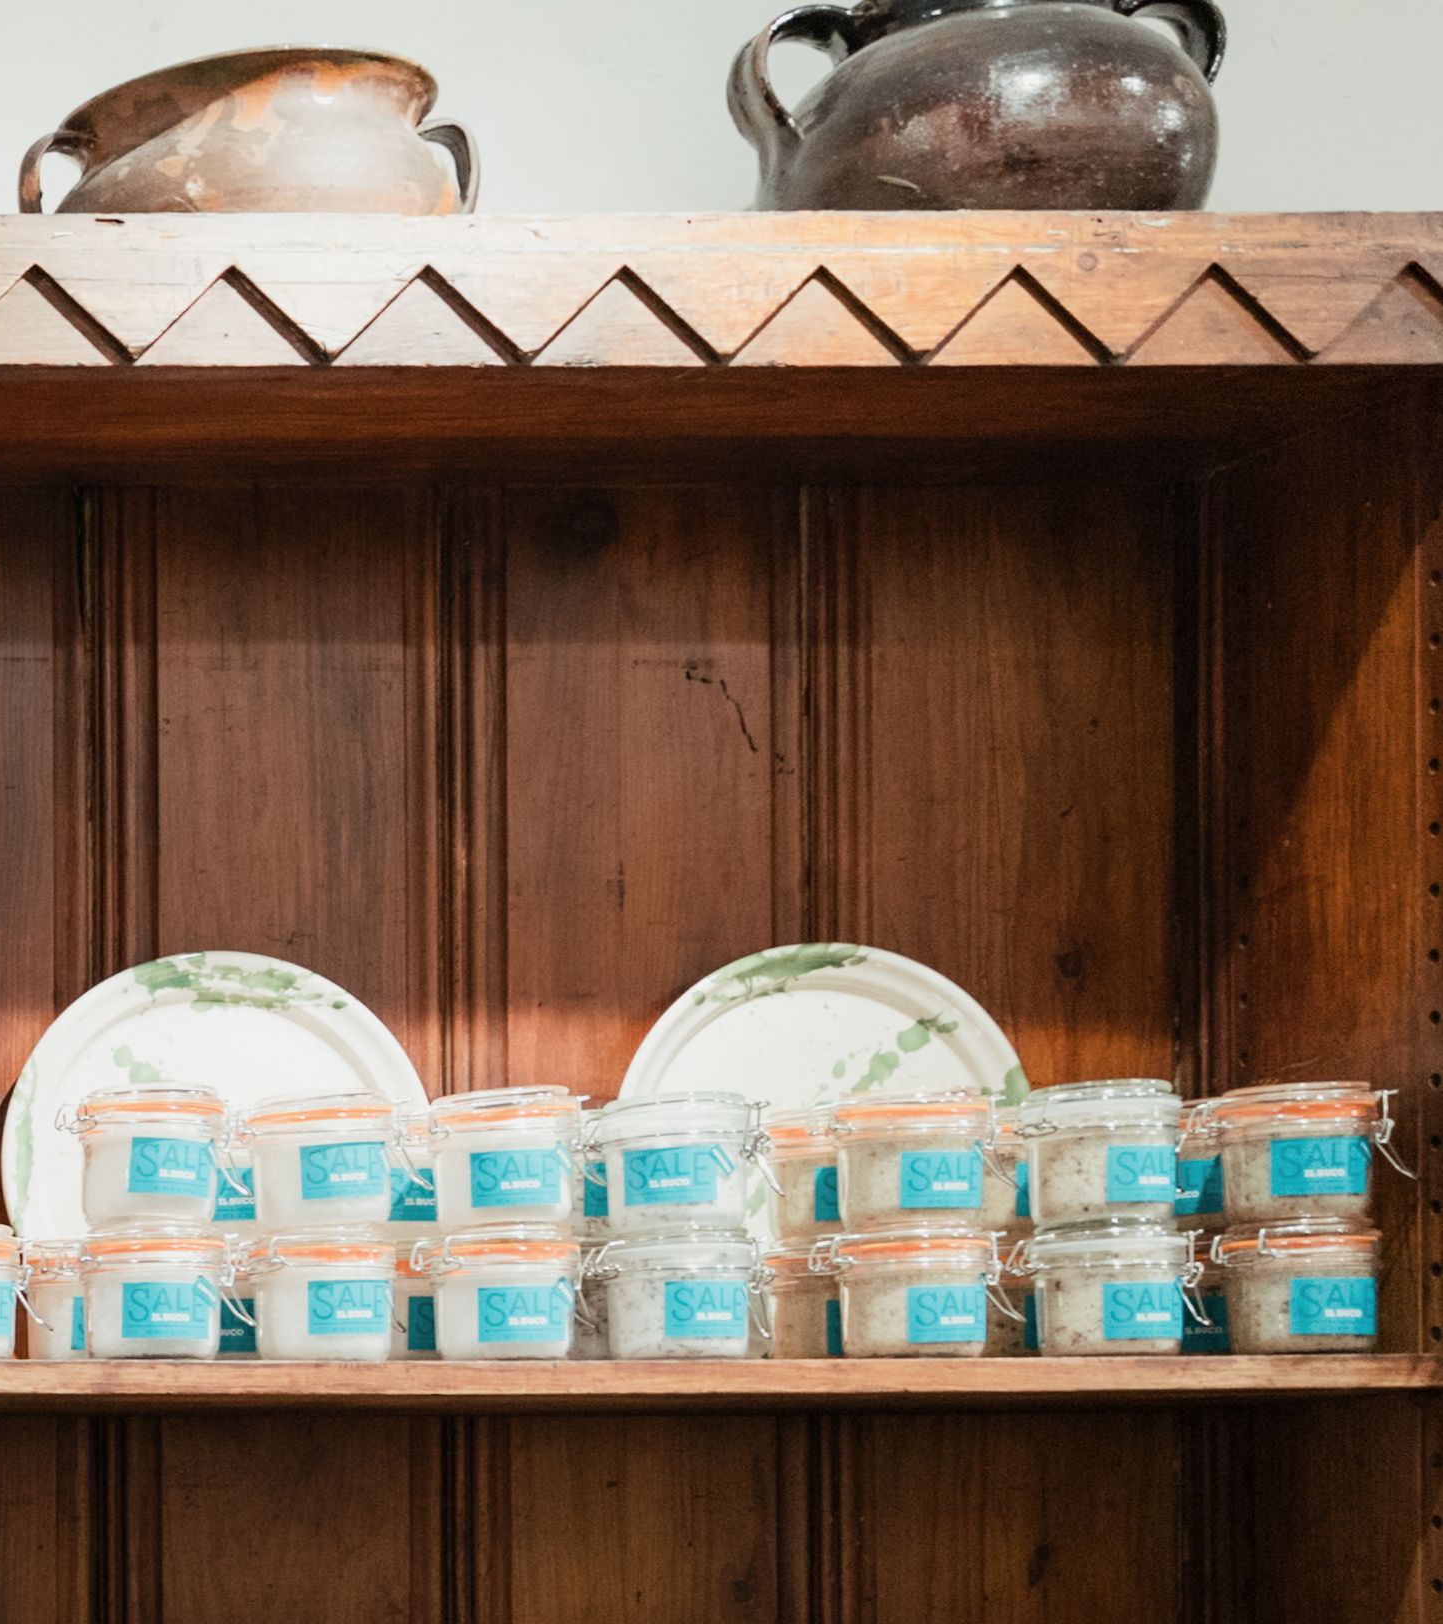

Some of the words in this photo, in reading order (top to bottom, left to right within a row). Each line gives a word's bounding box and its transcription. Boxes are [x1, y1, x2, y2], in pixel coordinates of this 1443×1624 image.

[134, 1140, 213, 1181] SALE
[173, 1169, 196, 1180] BUCO
[477, 1152, 557, 1192] SALE
[628, 1151, 711, 1190] SALE
[1316, 1168, 1346, 1178] BUCO
[514, 1179, 541, 1189] BUCO
[661, 1177, 691, 1188] BUCO
[126, 1286, 208, 1323] SALE
[313, 1283, 387, 1320] SALE
[484, 1290, 563, 1327] SALE
